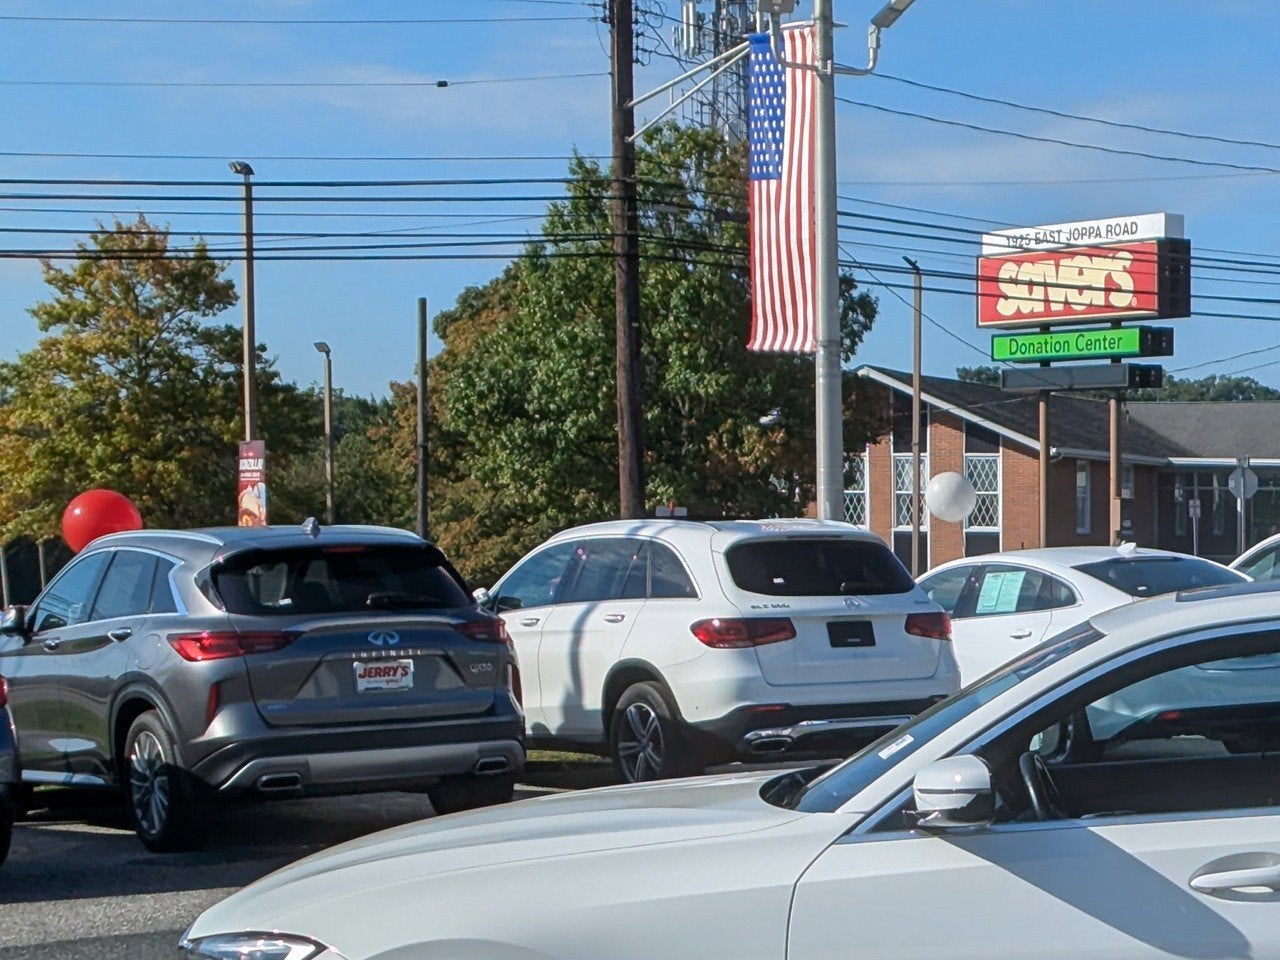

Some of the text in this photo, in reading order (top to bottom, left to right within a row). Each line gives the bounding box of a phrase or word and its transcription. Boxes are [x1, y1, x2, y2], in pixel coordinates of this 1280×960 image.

[1006, 221, 1138, 248] 1925 EAST JOPPA ROAD
[1009, 333, 1123, 355] Donation Center
[358, 665, 410, 679] JERRY'S
